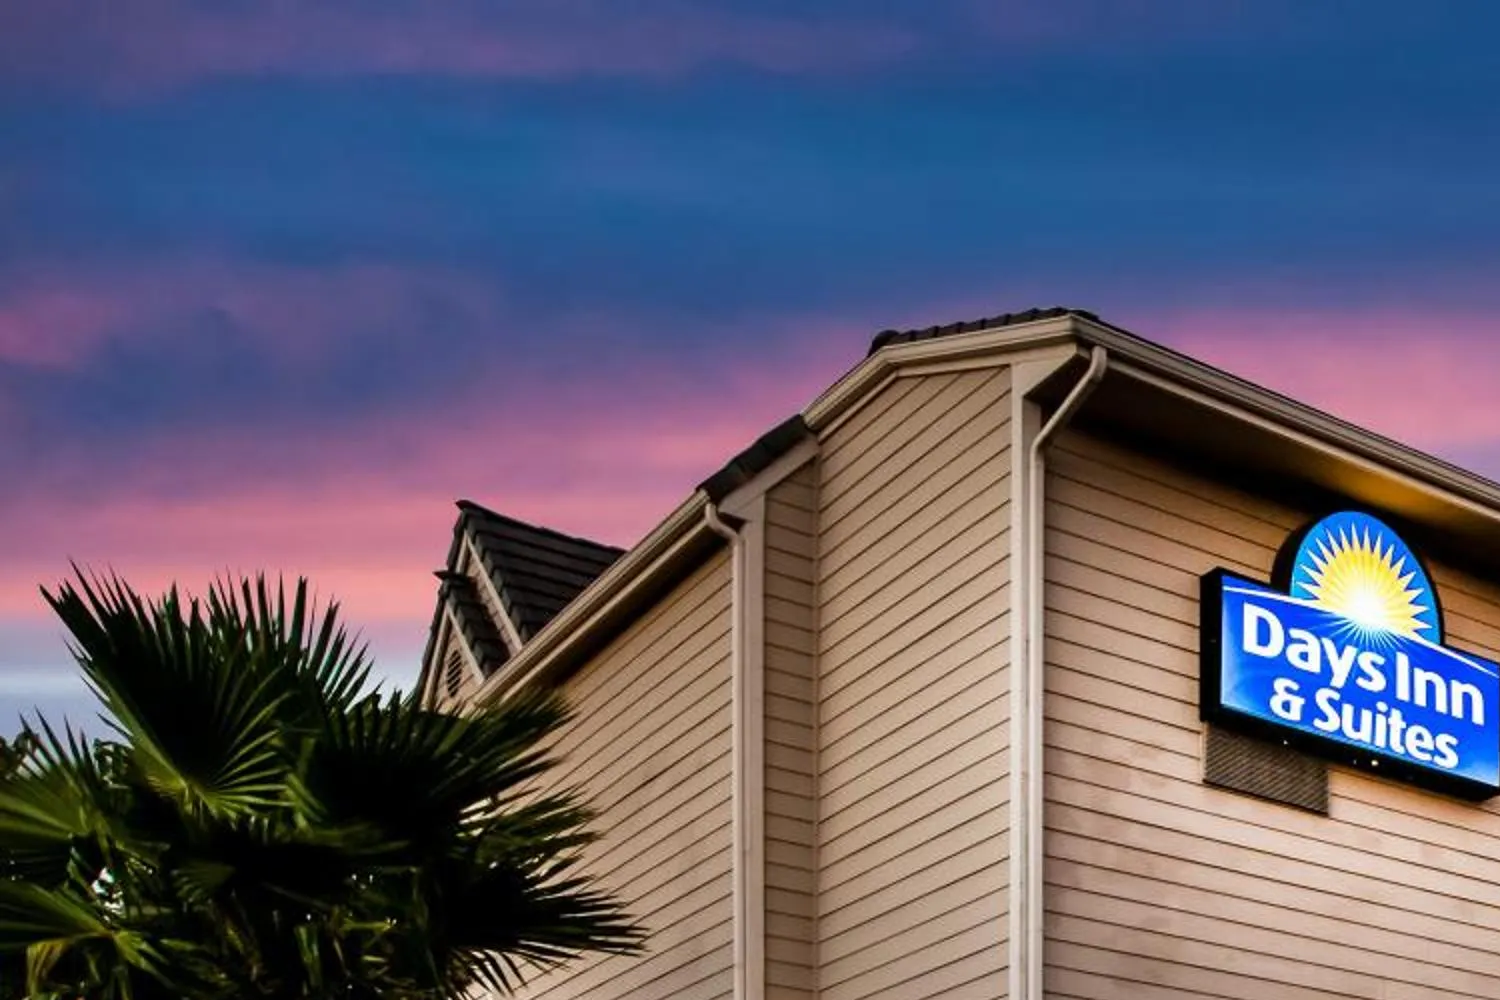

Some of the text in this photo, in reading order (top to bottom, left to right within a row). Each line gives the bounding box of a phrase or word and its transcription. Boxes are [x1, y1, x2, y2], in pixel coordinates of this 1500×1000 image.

[1242, 601, 1485, 726] Days Inn
[1269, 677, 1459, 770] & Suites
